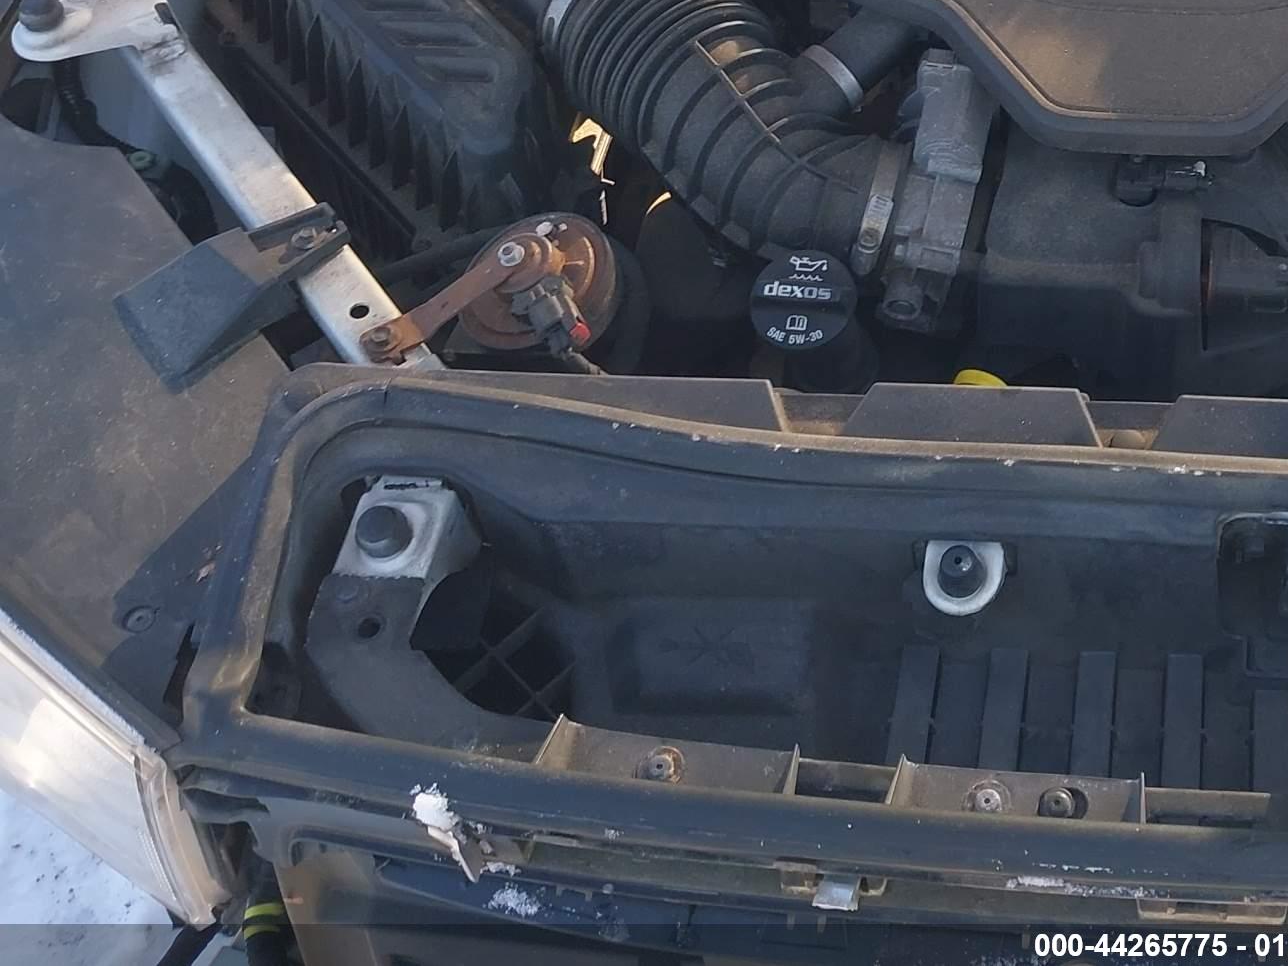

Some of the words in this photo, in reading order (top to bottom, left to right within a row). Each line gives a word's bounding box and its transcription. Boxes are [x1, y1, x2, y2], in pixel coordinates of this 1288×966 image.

[763, 281, 832, 300] dexos
[767, 327, 786, 342] SAE
[788, 330, 823, 345] 5W-30
